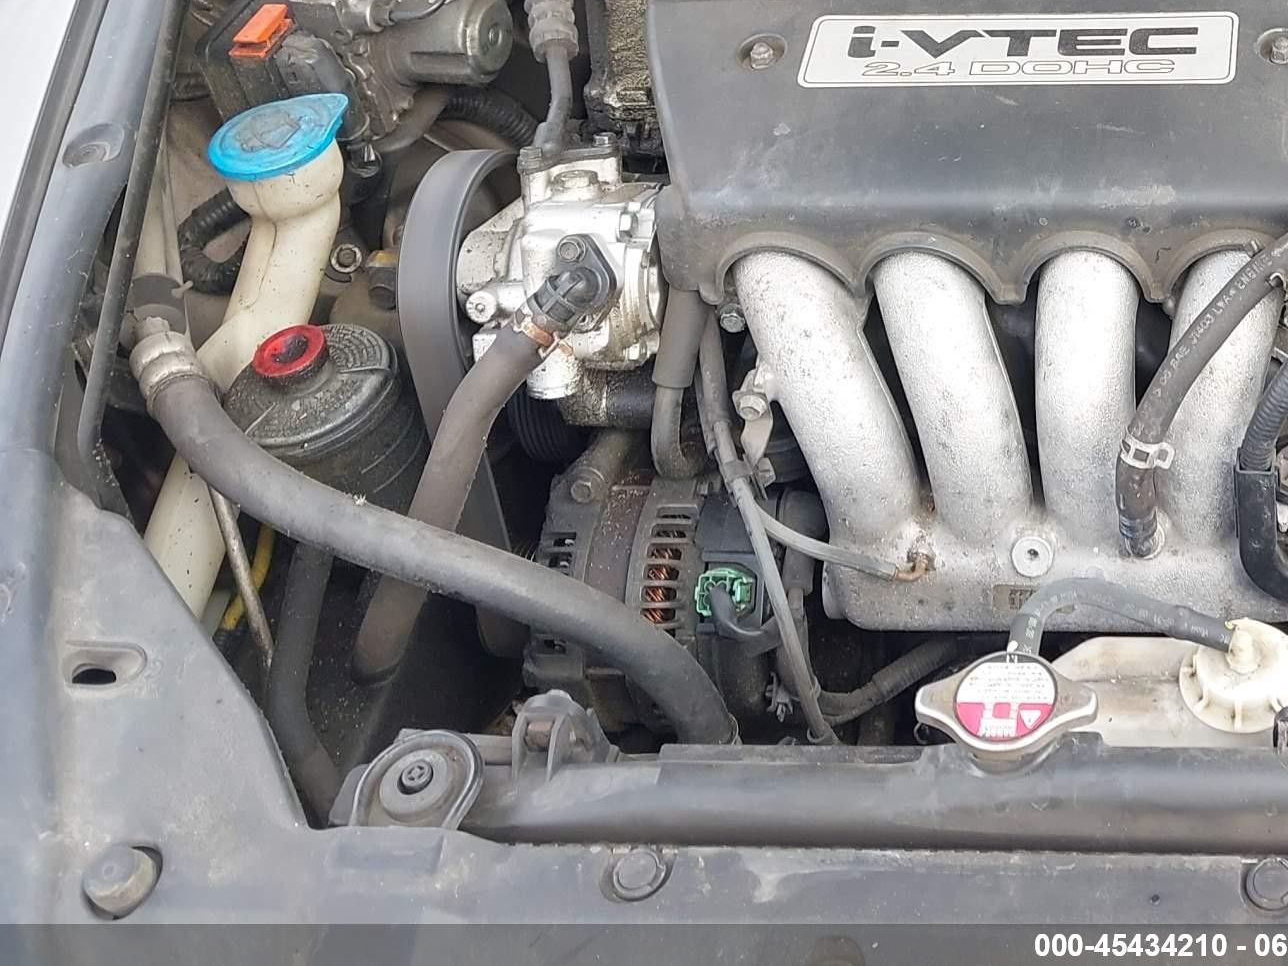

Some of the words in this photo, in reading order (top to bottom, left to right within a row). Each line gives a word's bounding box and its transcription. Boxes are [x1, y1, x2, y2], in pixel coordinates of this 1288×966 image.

[848, 25, 1199, 59] i-VTEC
[861, 60, 956, 77] 2.4
[968, 58, 1176, 76] DOHC
